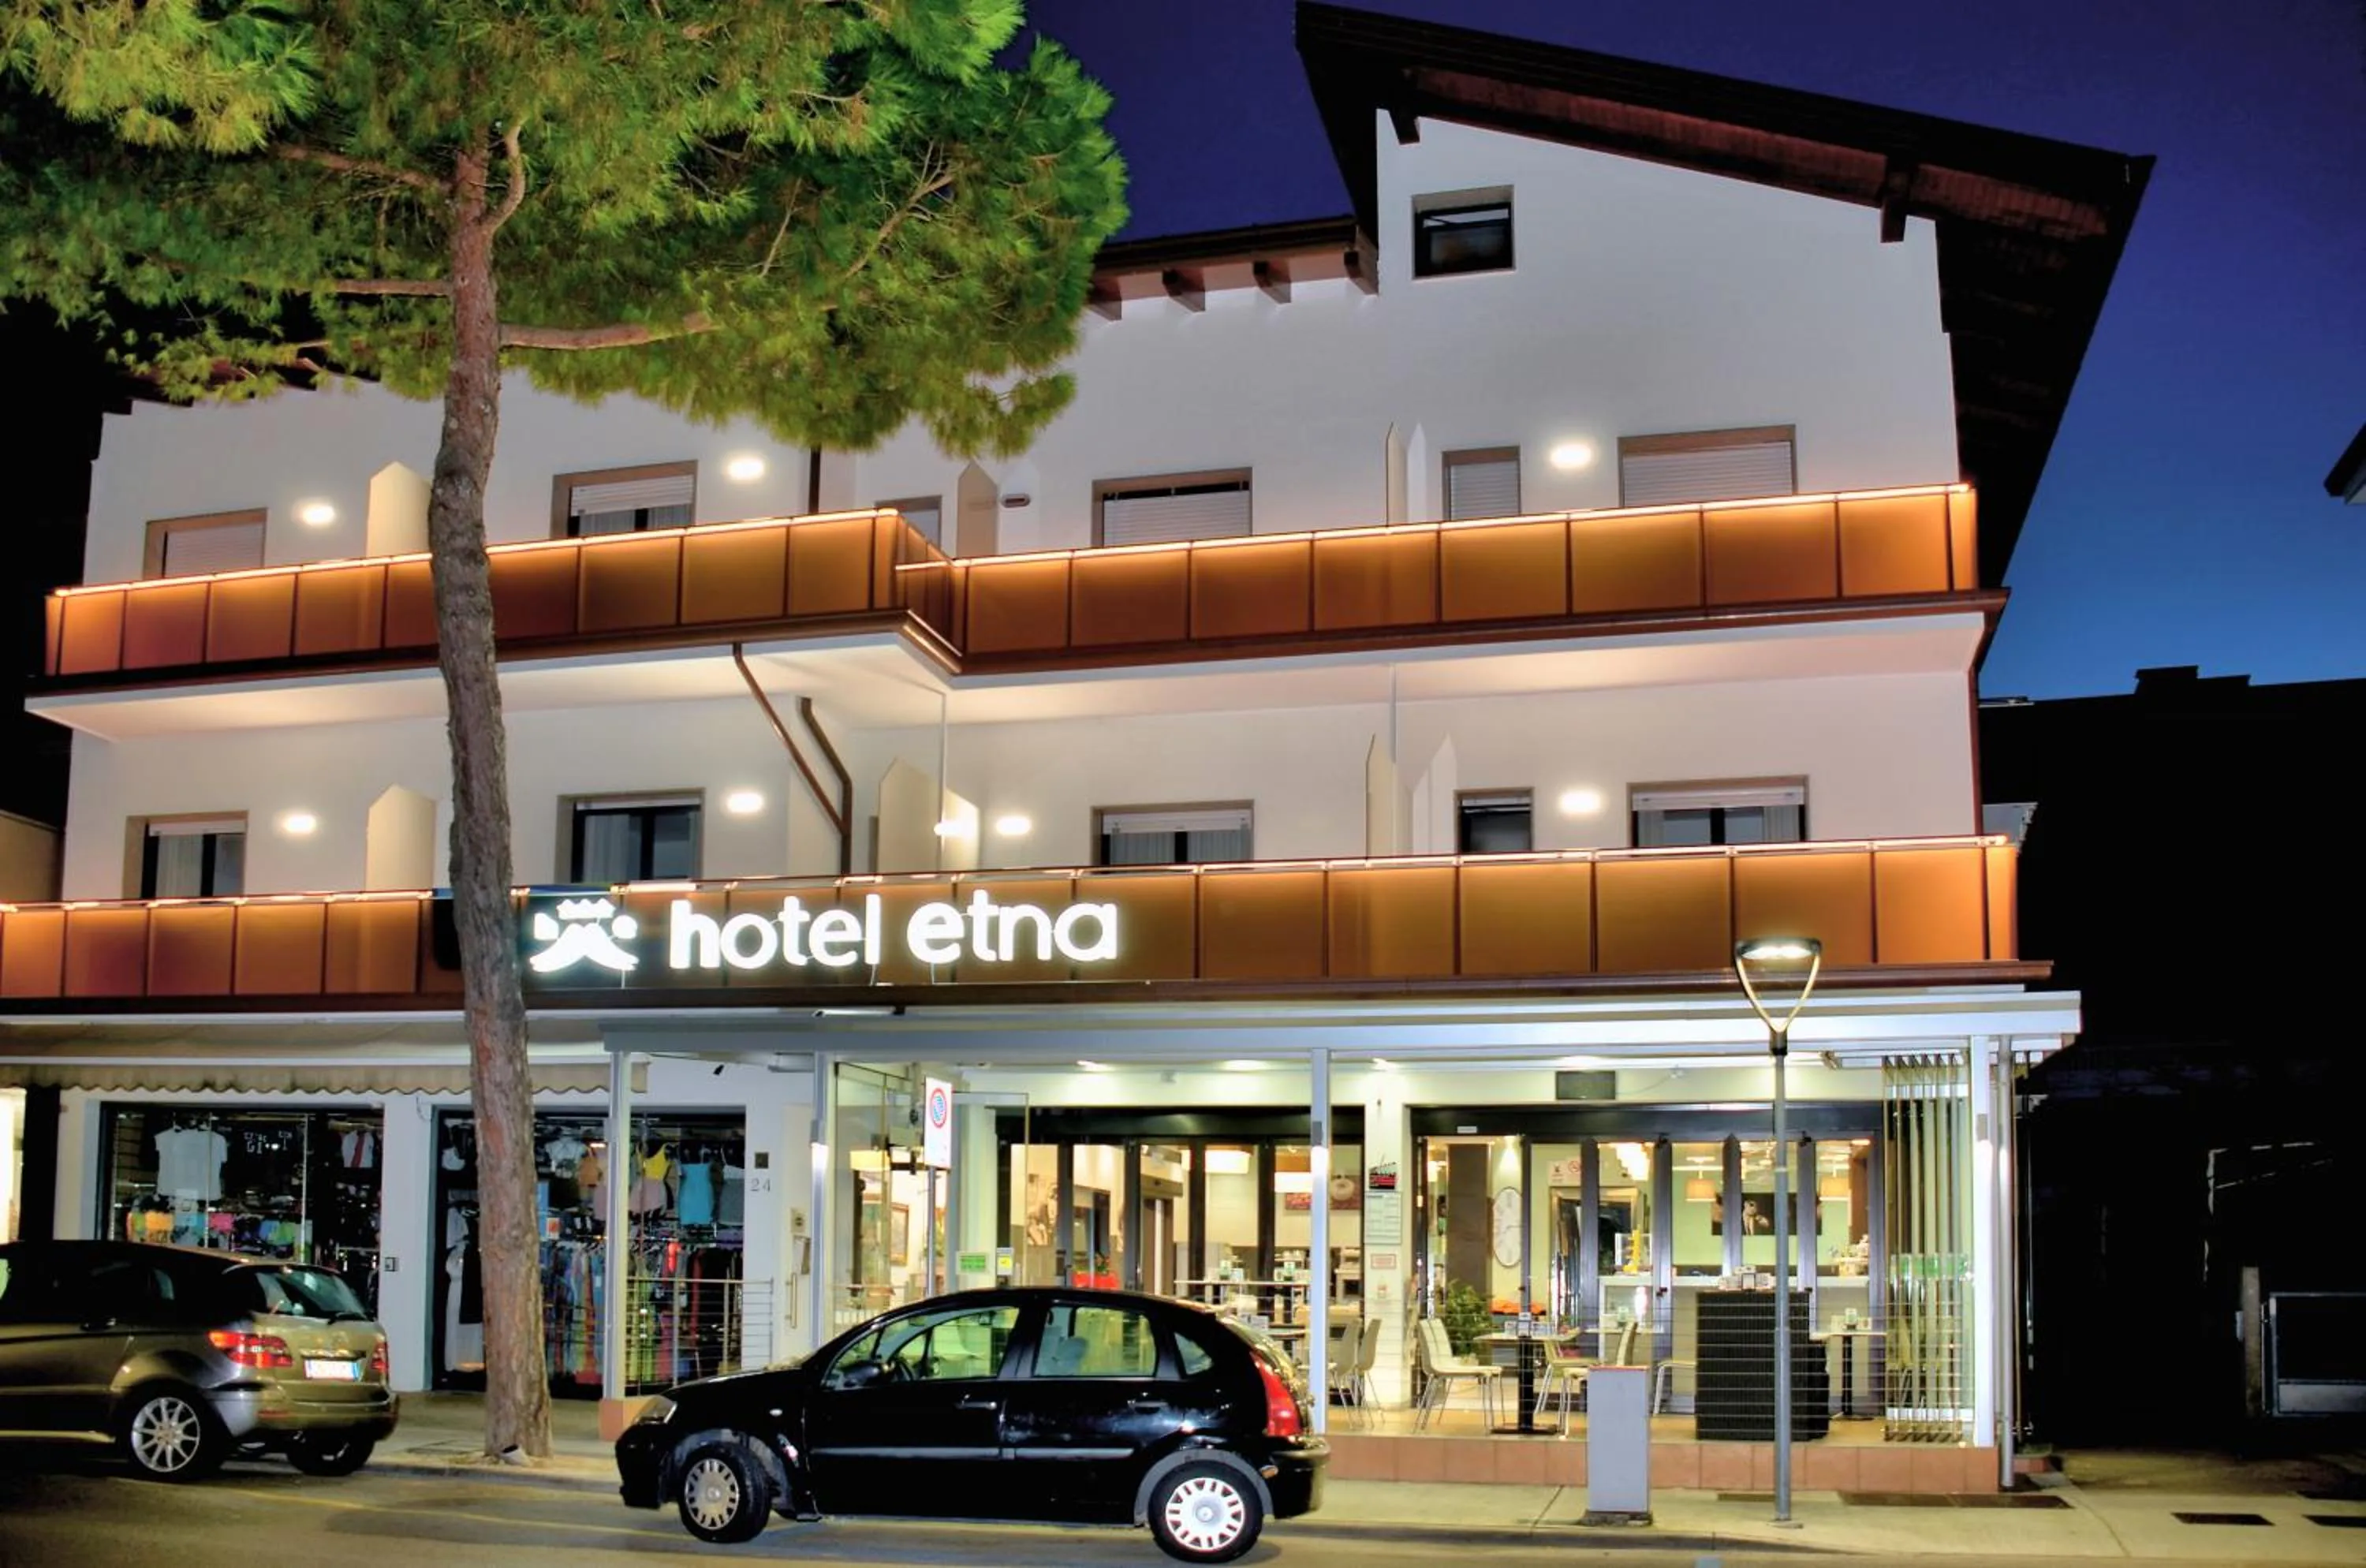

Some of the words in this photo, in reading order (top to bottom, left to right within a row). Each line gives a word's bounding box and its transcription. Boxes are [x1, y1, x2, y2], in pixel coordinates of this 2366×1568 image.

[670, 894, 881, 969] hotel
[907, 889, 1117, 964] etna
[750, 1178, 771, 1193] 24
